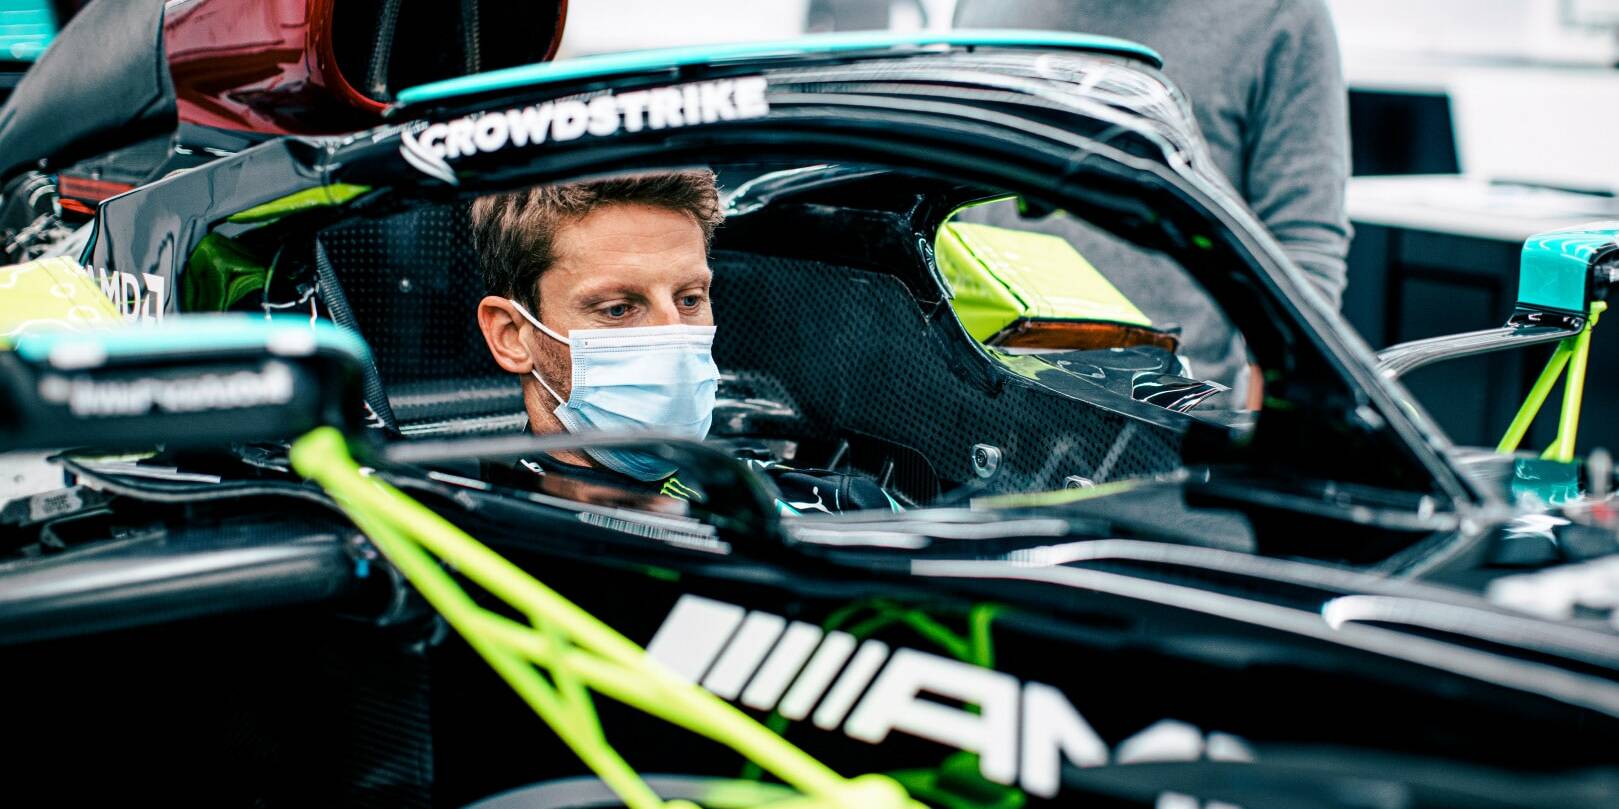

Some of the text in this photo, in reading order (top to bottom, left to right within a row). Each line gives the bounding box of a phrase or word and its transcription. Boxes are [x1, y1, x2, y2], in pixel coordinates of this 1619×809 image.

[419, 76, 770, 160] CROWDSTRIKE
[86, 265, 141, 323] MD
[843, 647, 1257, 809] AM
